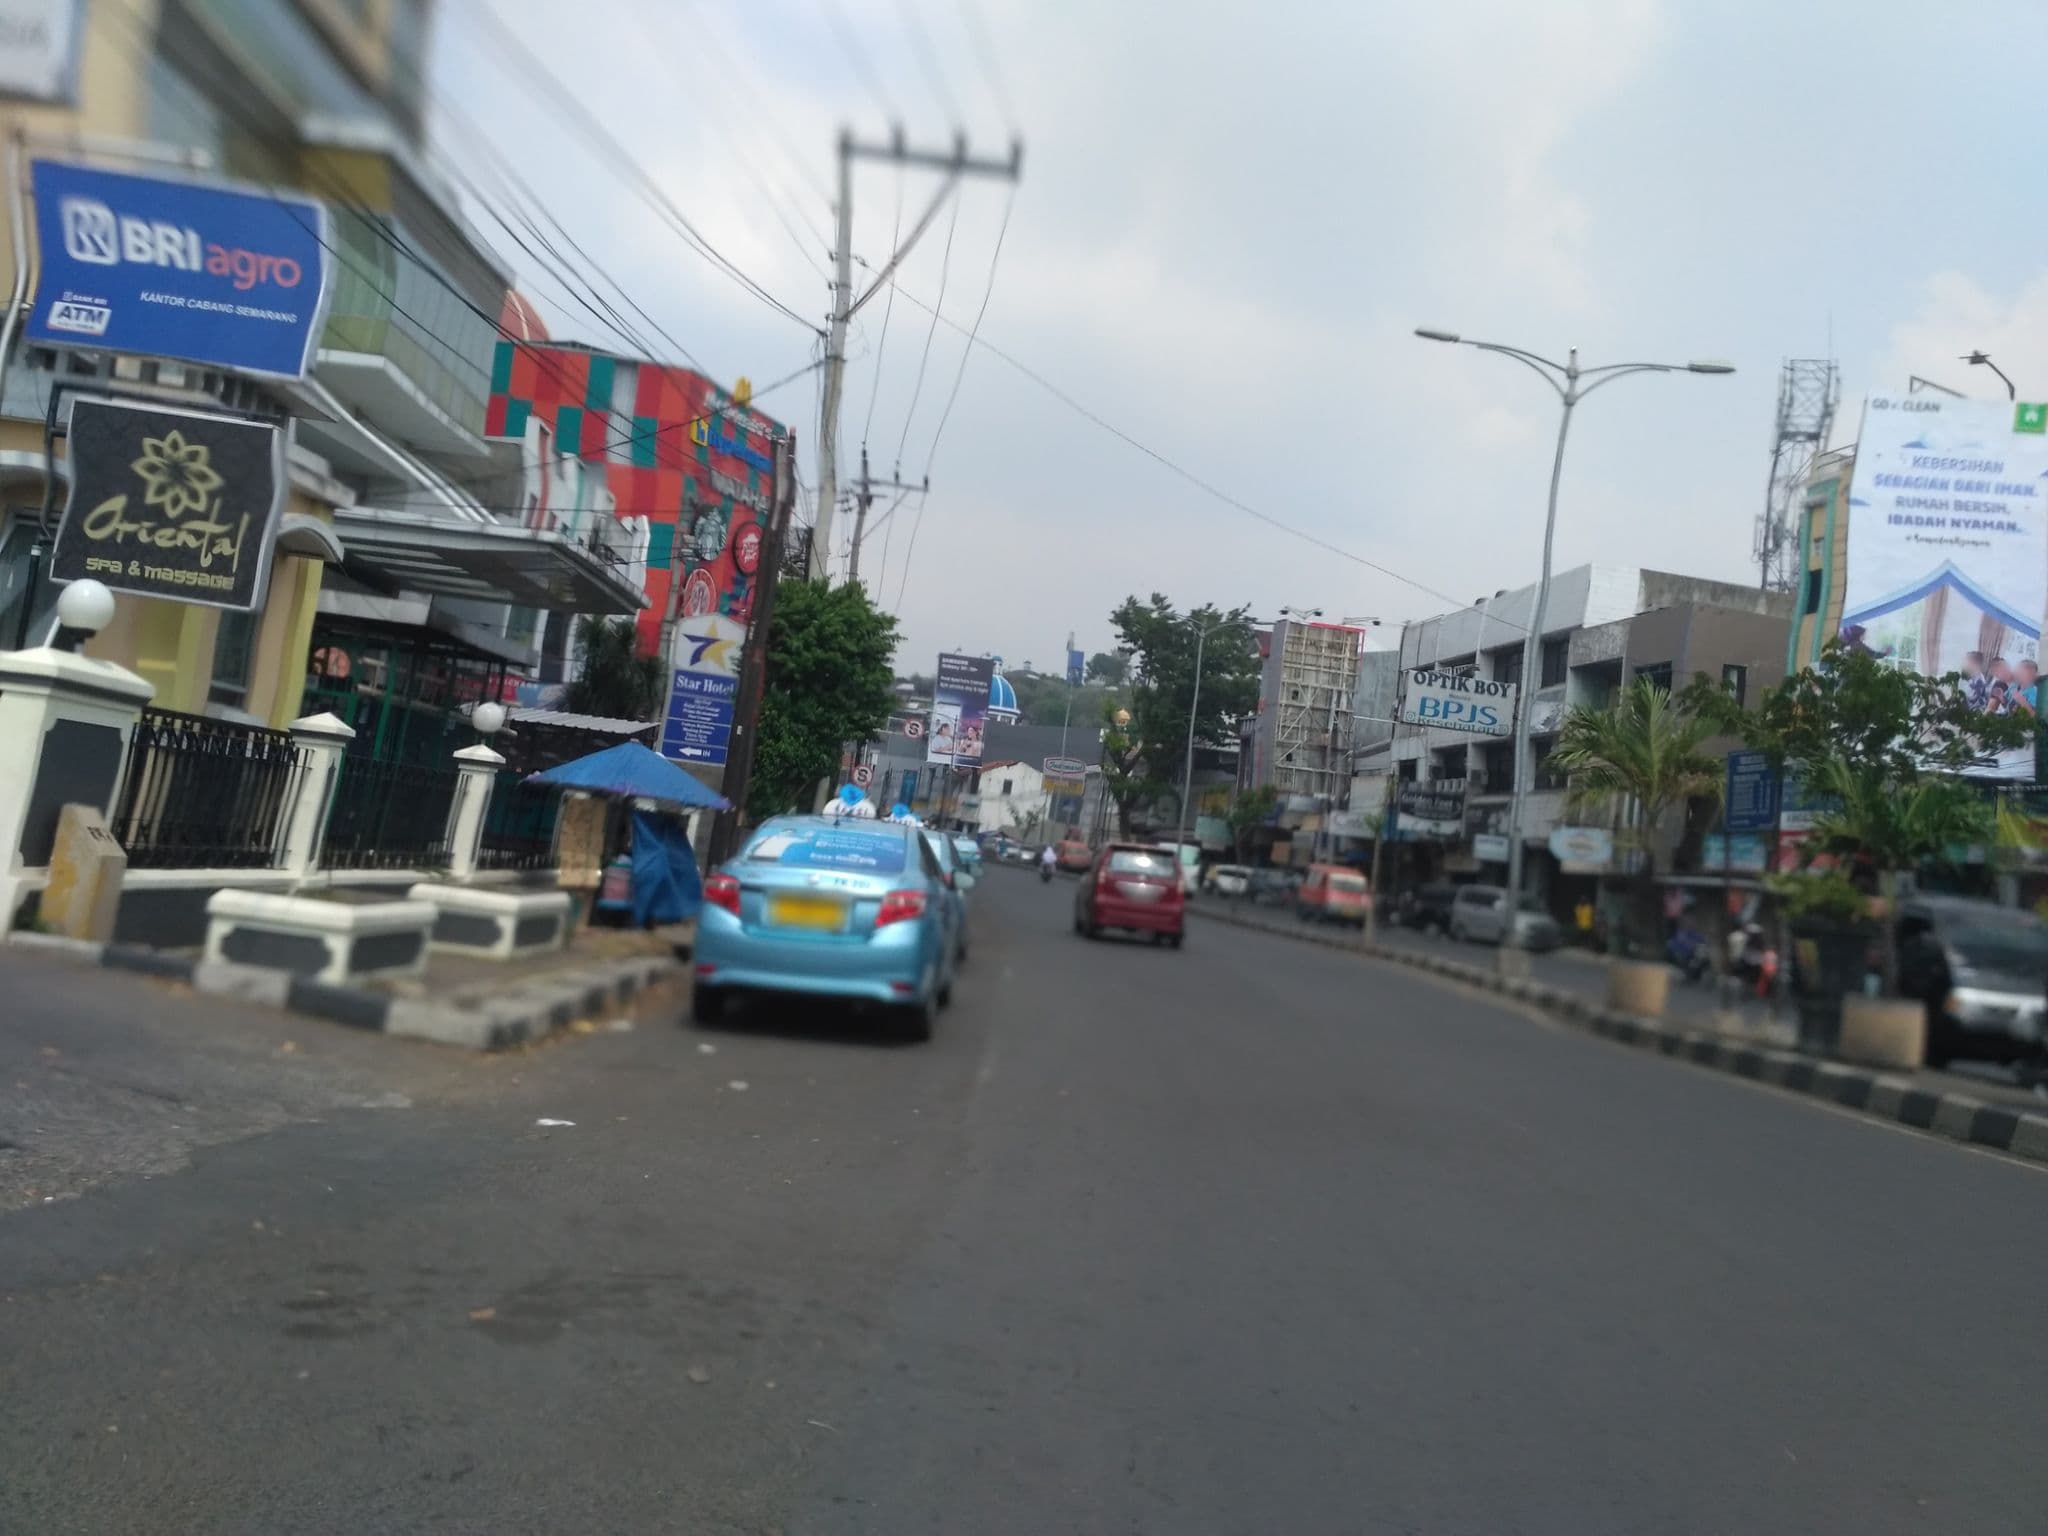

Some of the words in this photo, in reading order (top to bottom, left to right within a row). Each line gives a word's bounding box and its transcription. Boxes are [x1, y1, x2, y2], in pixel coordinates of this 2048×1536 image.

[120, 216, 201, 272] BRI
[206, 244, 302, 290] agro
[56, 304, 106, 326] ATM
[140, 291, 186, 308] KANTOR
[187, 299, 234, 314] CABANG
[234, 305, 298, 324] SEMARANG
[1871, 398, 1890, 410] GO
[1901, 400, 1942, 413] CLEAN
[1911, 455, 2005, 473] KEBERSIHAN
[1873, 473, 1950, 492] SEBAGIAN
[1953, 479, 1991, 493] DARI
[1895, 496, 1950, 511] RUMAH
[1887, 513, 1947, 529] IBADAH
[83, 495, 250, 575] Oriental
[128, 560, 142, 577] &
[676, 674, 701, 691] Star
[703, 679, 735, 696] Hotel
[1413, 671, 1470, 693] OPTIK
[1473, 679, 1512, 698] BOY
[1418, 695, 1498, 726] BPJS
